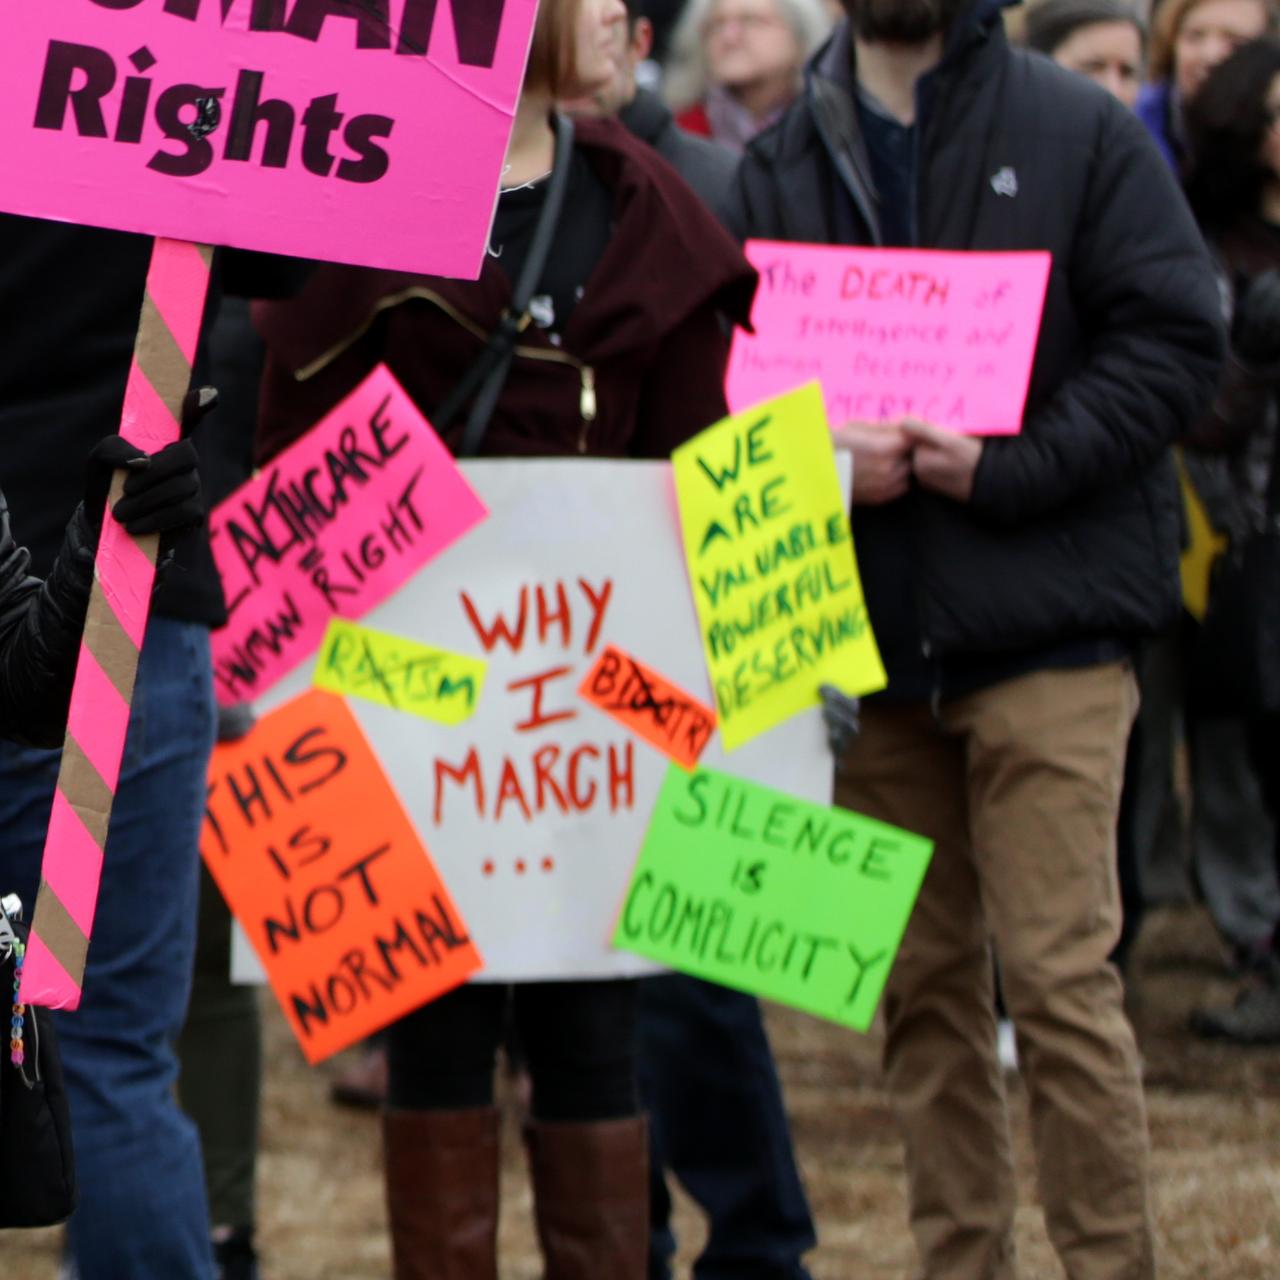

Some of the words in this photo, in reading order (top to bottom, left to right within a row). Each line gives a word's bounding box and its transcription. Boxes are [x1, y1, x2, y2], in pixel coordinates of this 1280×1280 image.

[33, 38, 394, 184] Rights
[762, 259, 816, 296] The
[840, 264, 949, 307] DEATH
[696, 414, 774, 491] WE
[829, 392, 966, 422] MERICA
[311, 465, 425, 612] RIGHT
[699, 475, 792, 556] ARE
[699, 511, 849, 608] VALUABLE
[460, 575, 612, 655] WHY
[708, 560, 850, 661] POWERFUL
[507, 664, 577, 731] I
[717, 605, 867, 721] DESERVING
[434, 739, 634, 827] MARCH
[672, 773, 902, 881] SILENCE
[263, 842, 391, 955] NOT
[267, 826, 332, 880] IS
[290, 891, 470, 1037] NORMAL
[623, 870, 889, 1007] COMPLICITY
